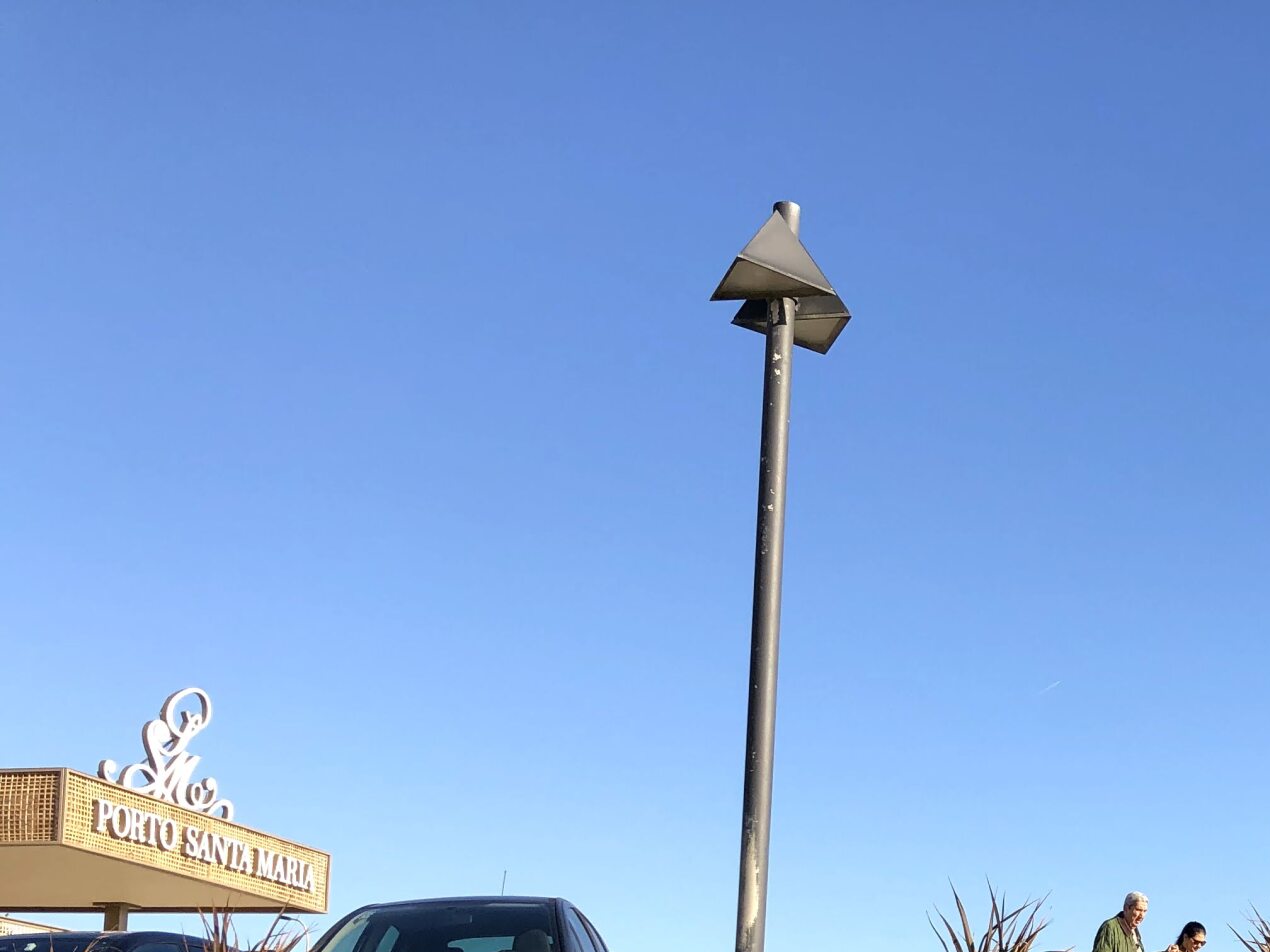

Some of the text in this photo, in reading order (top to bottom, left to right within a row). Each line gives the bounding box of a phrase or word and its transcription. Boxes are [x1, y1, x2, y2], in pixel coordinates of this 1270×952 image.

[95, 799, 315, 892] PORTO SANTA MARIA
